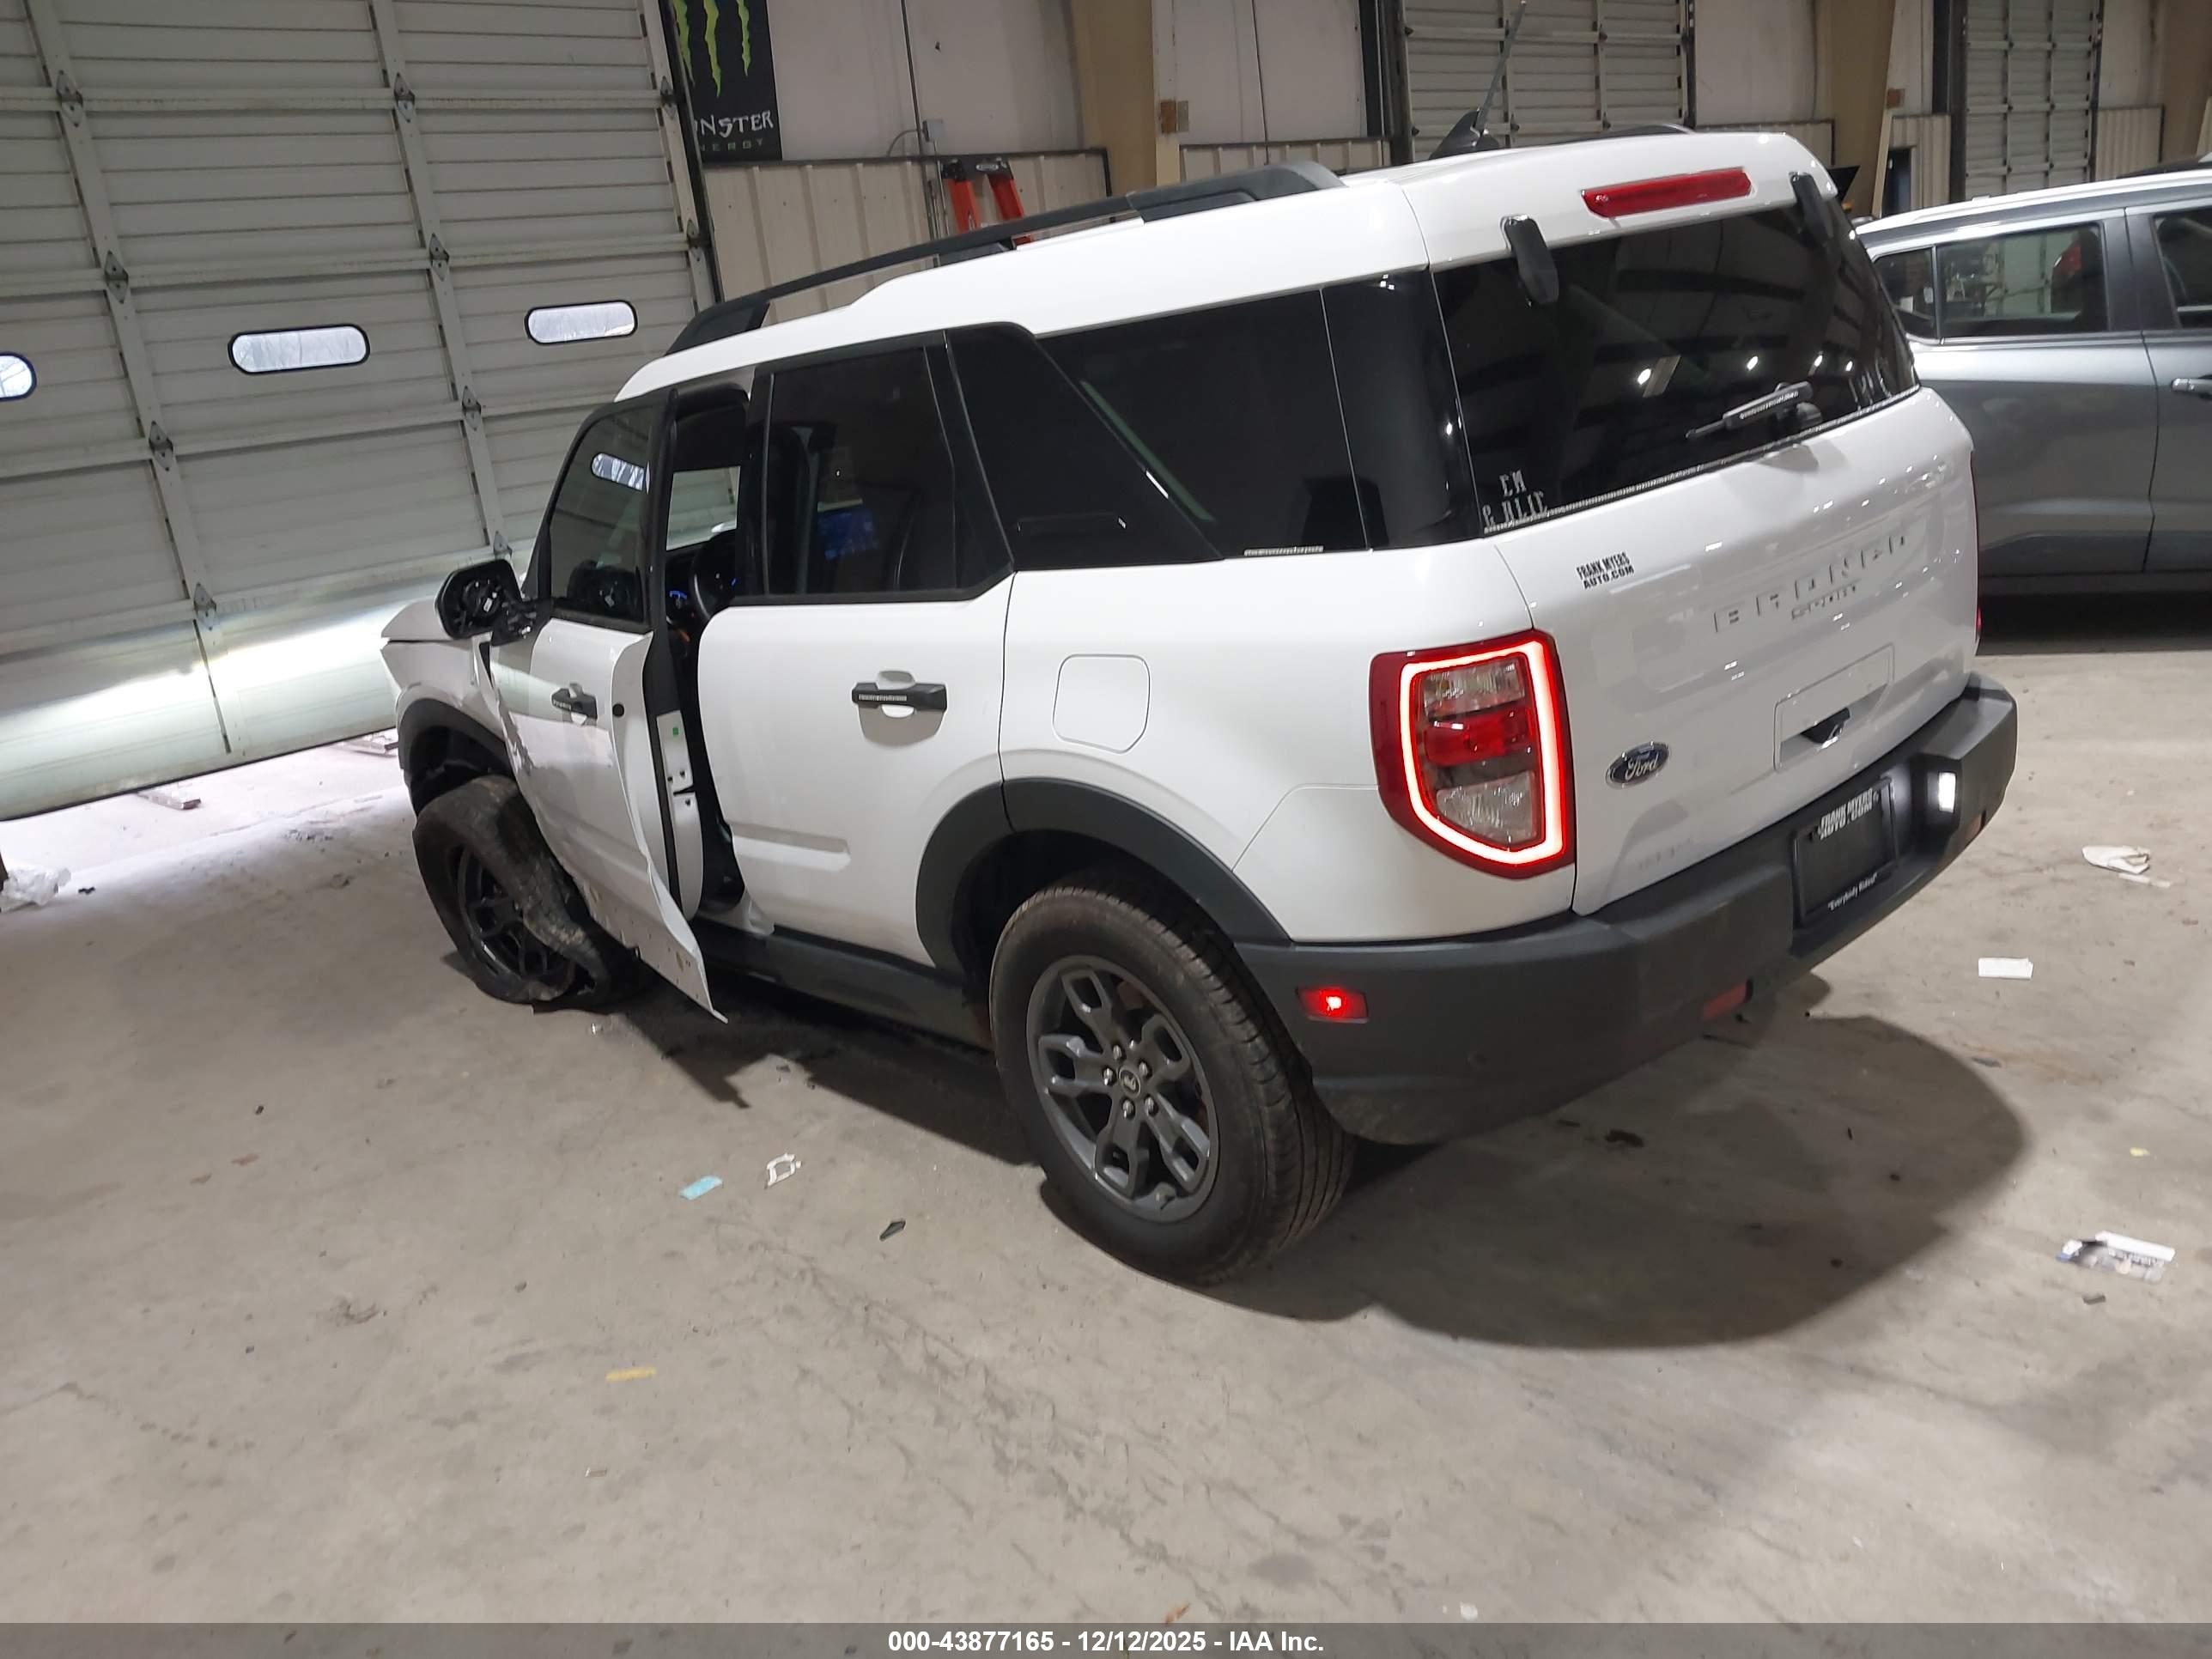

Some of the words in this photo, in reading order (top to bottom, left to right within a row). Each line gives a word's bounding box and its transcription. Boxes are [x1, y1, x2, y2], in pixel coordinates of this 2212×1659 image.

[1576, 559, 1605, 580] FRANK
[1601, 551, 1631, 571] MYERS
[1583, 565, 1635, 590] AUTO.COM
[1625, 750, 1660, 781] Ford
